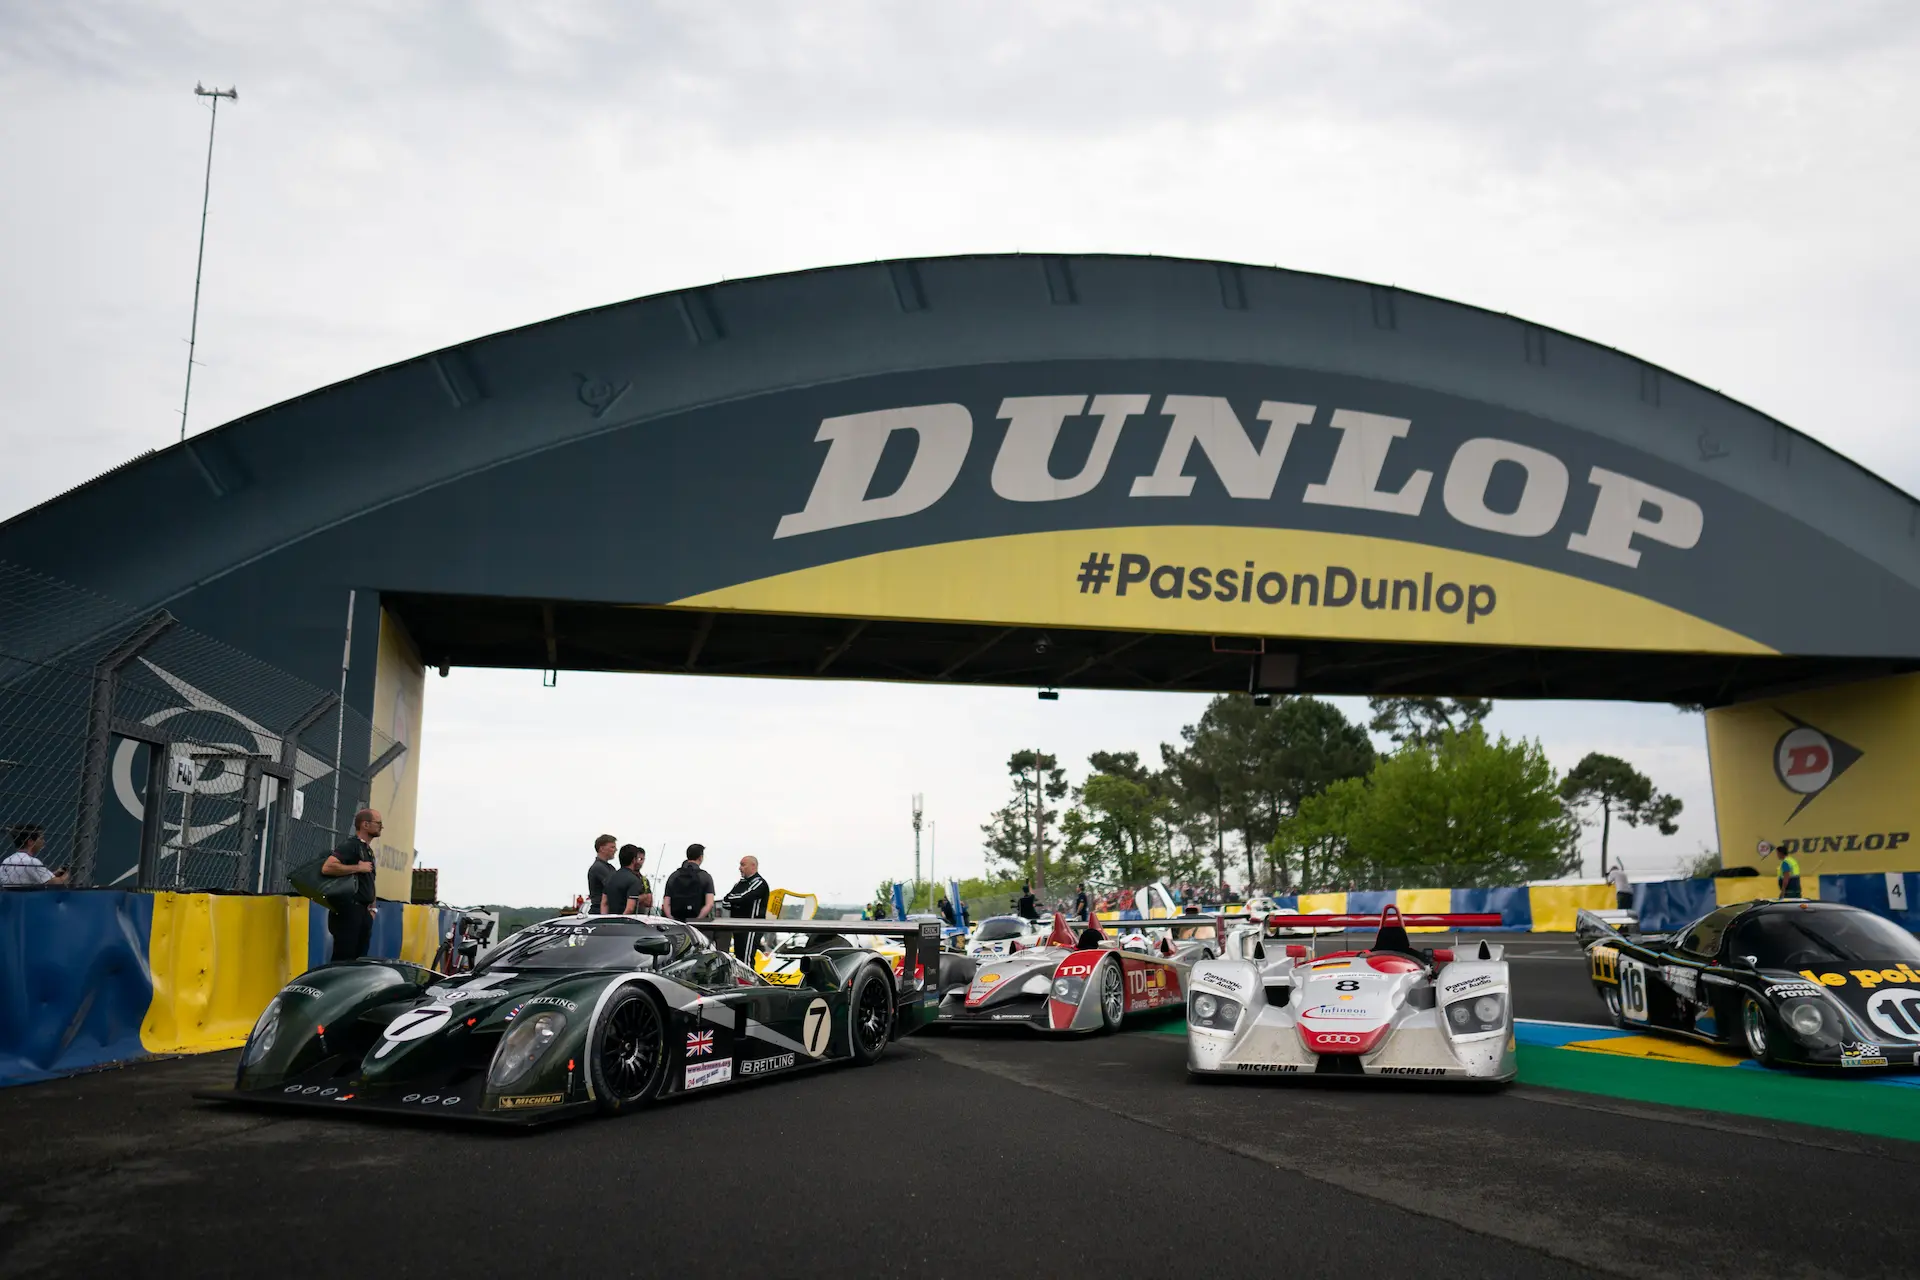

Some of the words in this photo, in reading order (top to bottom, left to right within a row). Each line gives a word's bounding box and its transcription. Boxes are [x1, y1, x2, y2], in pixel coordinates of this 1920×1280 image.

[773, 393, 1704, 569] DUNLOP
[1077, 552, 1497, 624] #PassionDunlop
[1781, 832, 1910, 855] DUNLOP
[1891, 884, 1902, 897] 4
[525, 925, 597, 935] NTLEY
[1060, 965, 1091, 976] TDI
[1799, 969, 1847, 987] le
[1849, 963, 1920, 988] poi
[1127, 969, 1148, 995] TDI
[1203, 971, 1242, 989] Panasonic
[1216, 981, 1236, 991] Audio
[1335, 980, 1360, 991] 8
[1445, 974, 1491, 991] Panasonic
[1452, 985, 1467, 993] Car
[1470, 979, 1492, 988] Audio
[1622, 967, 1644, 1012] 16
[1777, 989, 1822, 999] TOTAL
[1320, 1004, 1367, 1014] Infineon
[389, 1009, 449, 1036] 7
[809, 1007, 828, 1052] 7
[742, 1055, 794, 1073] BREITLING
[1237, 1063, 1299, 1072] MICHELIN
[1380, 1066, 1446, 1075] MICHELIN
[514, 1095, 562, 1105] MICHELIN
